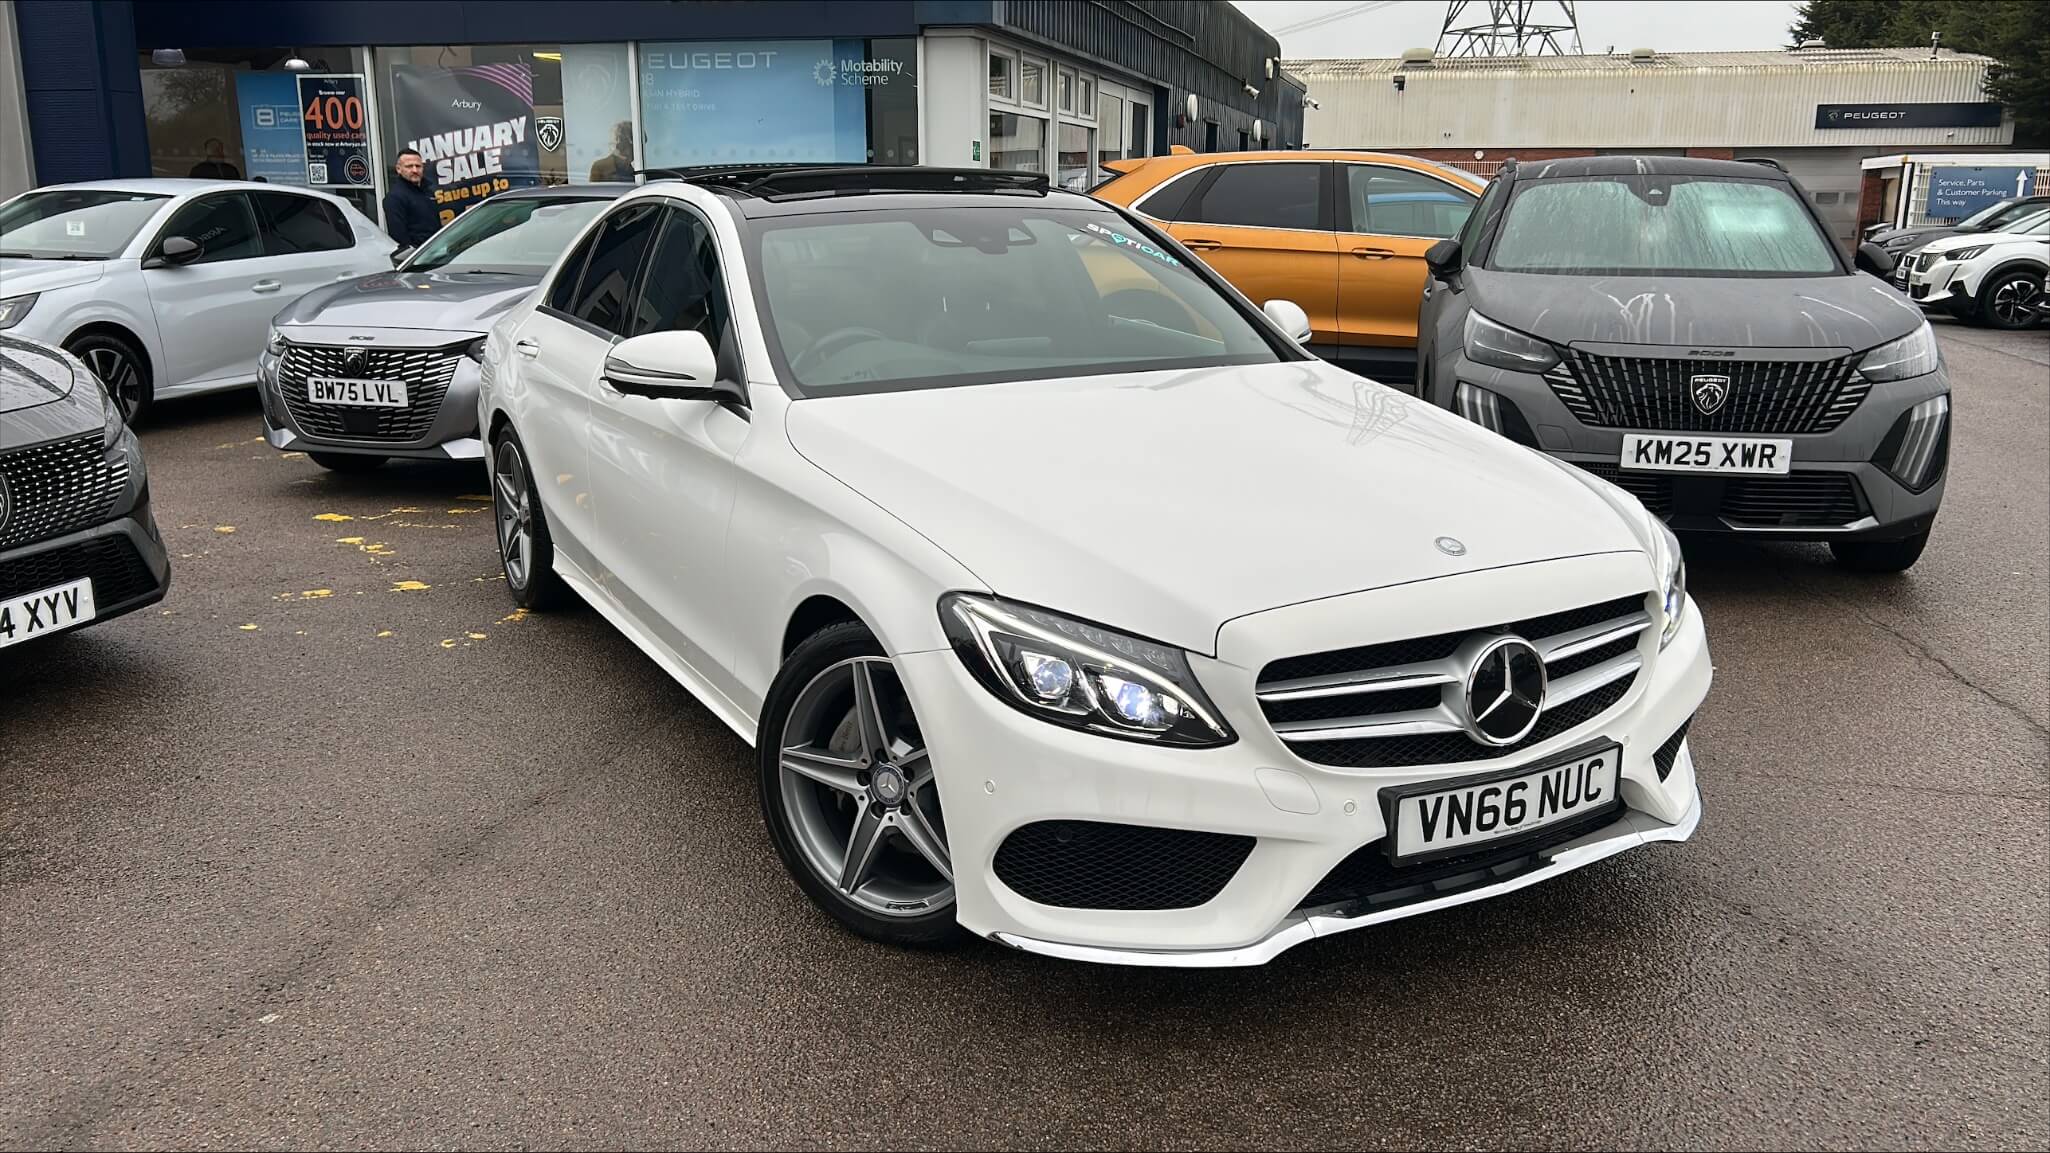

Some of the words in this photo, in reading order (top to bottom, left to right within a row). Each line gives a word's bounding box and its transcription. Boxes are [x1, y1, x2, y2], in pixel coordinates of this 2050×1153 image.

[841, 59, 903, 75] Motability
[841, 74, 889, 85] Scheme
[305, 96, 363, 129] 400
[451, 99, 482, 112] Arbury
[1844, 111, 1906, 119] PEUGEOT
[306, 131, 331, 140] quality
[333, 131, 350, 139] used
[436, 149, 503, 185] SALE
[435, 189, 469, 204] Save
[472, 182, 490, 197] up
[493, 178, 509, 192] to
[1967, 179, 1985, 187] Parts
[1945, 188, 1981, 196] Customer
[1982, 188, 2008, 198] Parking
[1937, 198, 1951, 206] This
[1952, 200, 1966, 208] way
[315, 381, 359, 401] BW75
[363, 383, 400, 404] LVL
[1635, 439, 1713, 467] KM25
[1720, 443, 1777, 469] XWR
[0, 607, 16, 639] 4
[23, 587, 79, 633] XYV
[1418, 781, 1528, 843] VN66
[1538, 758, 1605, 819] NUC
